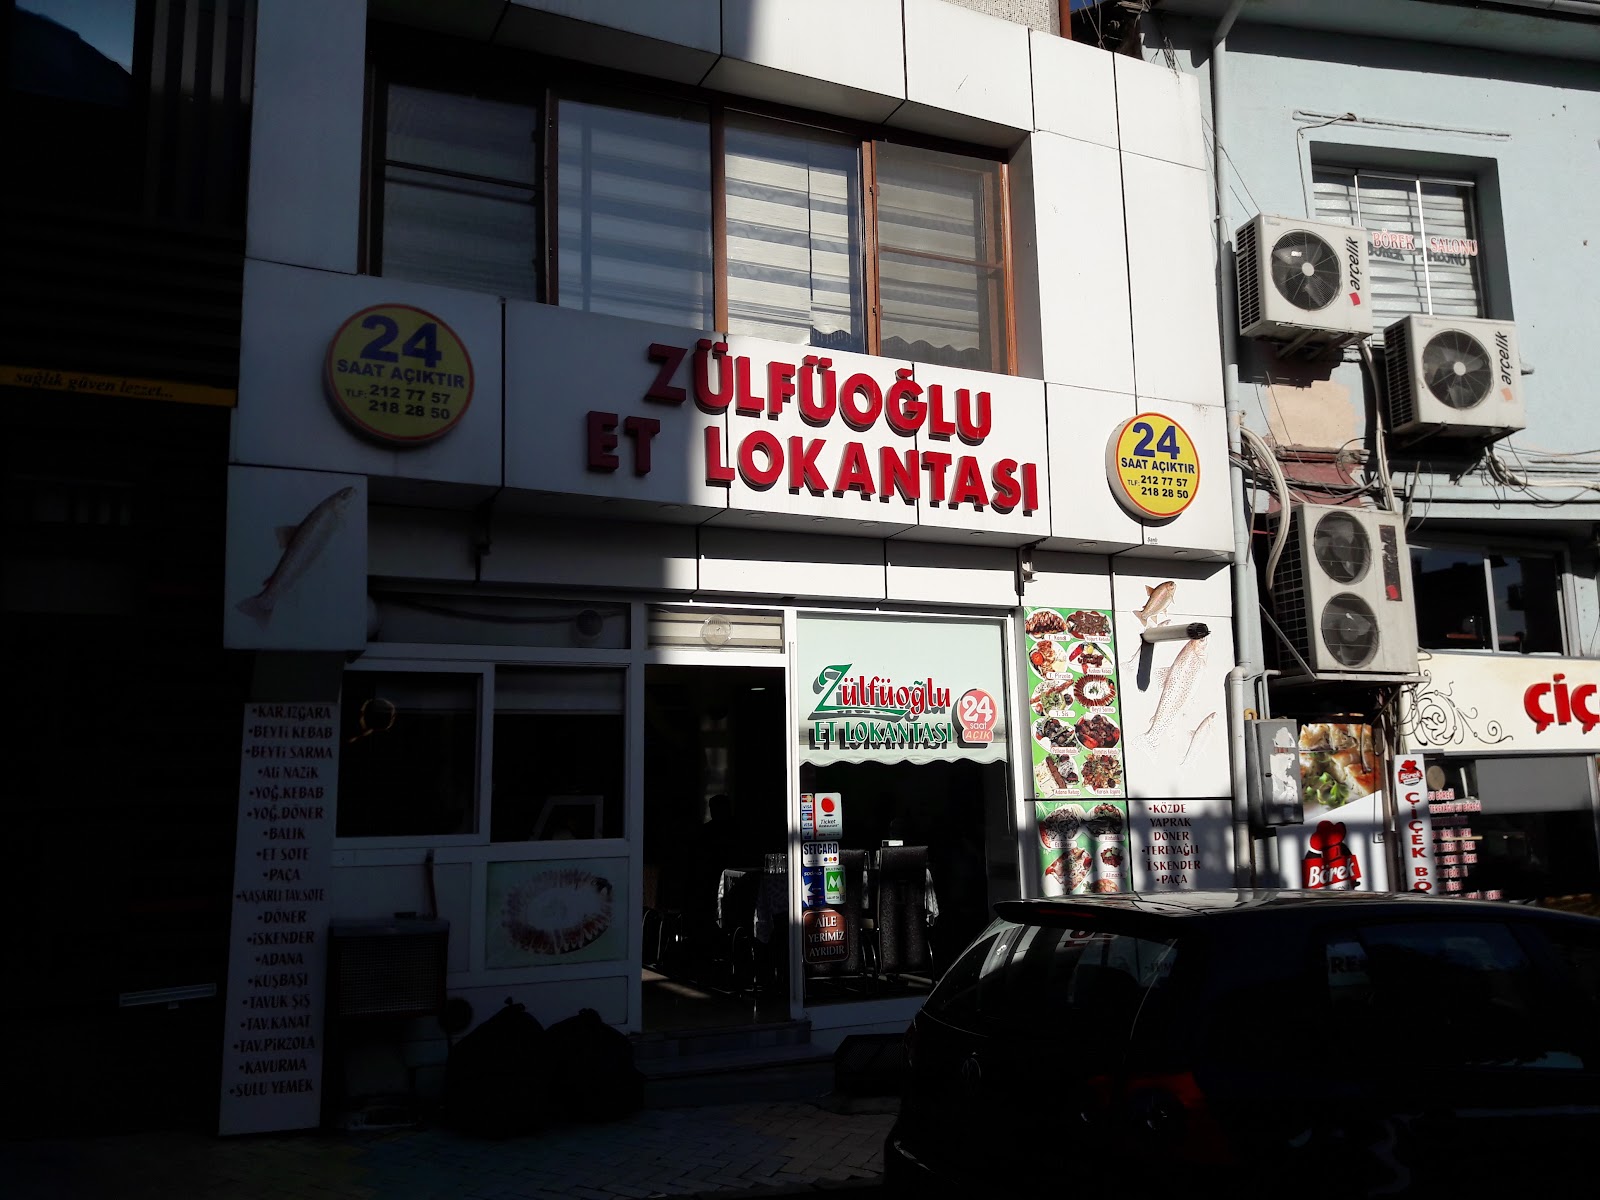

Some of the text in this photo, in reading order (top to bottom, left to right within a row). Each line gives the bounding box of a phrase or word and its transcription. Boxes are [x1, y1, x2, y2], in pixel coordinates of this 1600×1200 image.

[1372, 229, 1478, 256] BÖREK SALONU
[1346, 236, 1361, 291] arçelik
[360, 315, 442, 368] 24
[1495, 331, 1512, 385] arçelik
[337, 359, 465, 388] SAAT AÇIKTIR
[369, 385, 400, 398] 212
[406, 389, 425, 401] 77
[431, 392, 450, 404] 57
[645, 338, 992, 446] ZÜLFÜOĞLU
[369, 400, 450, 419] 218 28 50
[1132, 422, 1180, 460] 24
[587, 411, 1039, 517] ET LOKANTASI
[1121, 457, 1195, 474] SAAT AÇIKTIR
[1141, 475, 1158, 485] 212
[1162, 477, 1173, 486] 77
[1177, 479, 1188, 487] 57
[1141, 487, 1188, 498] 218 28 50
[813, 663, 950, 715] Zülfüoğlu
[962, 695, 993, 722] 24
[292, 726, 332, 739] KEBAB
[814, 721, 953, 743] ET LOKANTASI
[970, 722, 987, 730] saat
[965, 730, 990, 741] AÇIK
[290, 746, 333, 759] SARMA
[1401, 772, 1421, 781] Börek
[254, 785, 324, 801] YOĞ.KEBAB
[253, 804, 323, 821] YOĞ.DÖNER
[1153, 802, 1186, 813] KÖZDE
[1150, 818, 1191, 827] YAPRAK
[1405, 792, 1427, 858] ÇİÇEK
[269, 828, 305, 840] BALIK
[1154, 830, 1189, 841] DÖNER
[262, 848, 309, 861] ET SOTE
[804, 843, 838, 855] SETCARD
[1145, 843, 1199, 856] TEREYAĞLI
[1146, 859, 1201, 871] İSKENDER
[1308, 857, 1355, 887] Börek
[269, 869, 300, 883] PAÇA
[1161, 875, 1187, 886] PAÇA
[264, 910, 306, 924] DÖNER
[815, 915, 837, 927] AİLE
[808, 929, 845, 943] YERİMİZ
[809, 945, 845, 958] AYRIDIR
[261, 953, 304, 966] ADANA
[254, 973, 308, 989] KUŞBAŞI
[250, 996, 287, 1009] TAVUK
[247, 1014, 311, 1031] TAV.KANAT
[245, 1058, 307, 1074] KAVURMA
[236, 1079, 313, 1097] SULU YEMEK
